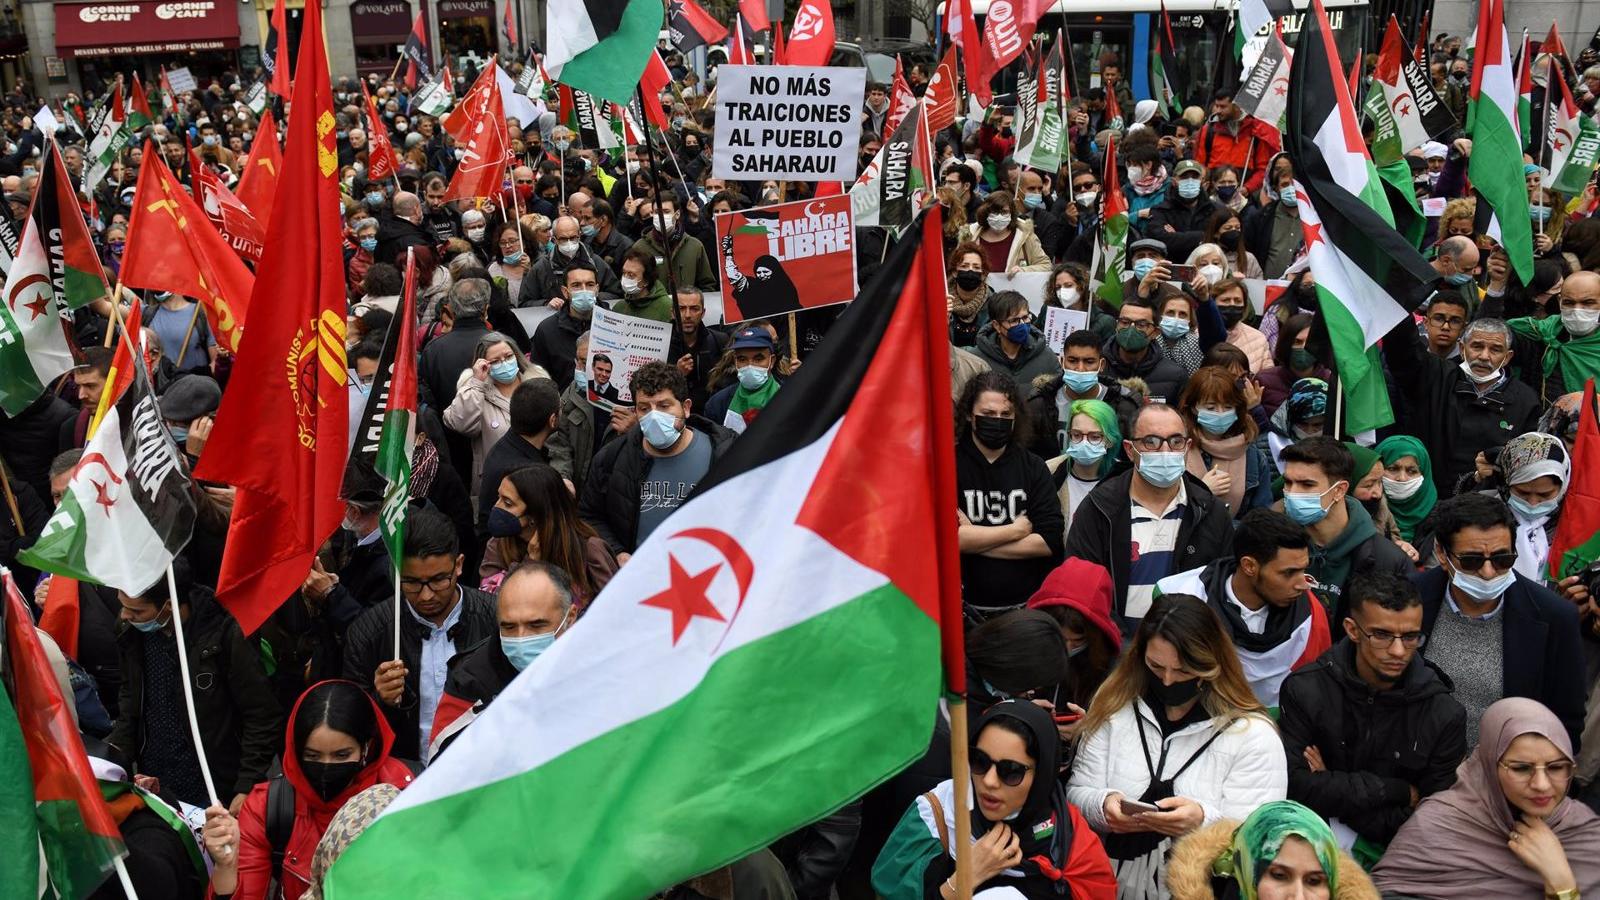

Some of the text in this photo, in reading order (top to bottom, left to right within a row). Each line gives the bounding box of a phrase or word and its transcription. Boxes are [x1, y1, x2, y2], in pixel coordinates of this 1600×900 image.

[91, 5, 140, 14] CORNER
[167, 2, 215, 11] CORNER
[190, 41, 224, 49] ENSALADAS
[750, 73, 831, 97] NO MÁS
[725, 102, 851, 123] TRAICIONES
[1366, 92, 1395, 143] LLIURE
[728, 128, 843, 149] AL PUEBLO
[732, 153, 836, 173] SAHARAUI
[766, 210, 850, 240] SAHARA
[0, 215, 18, 257] SÀHAR
[769, 226, 851, 262] LIBRE
[640, 480, 697, 500] HILL
[963, 489, 1028, 525] USC
